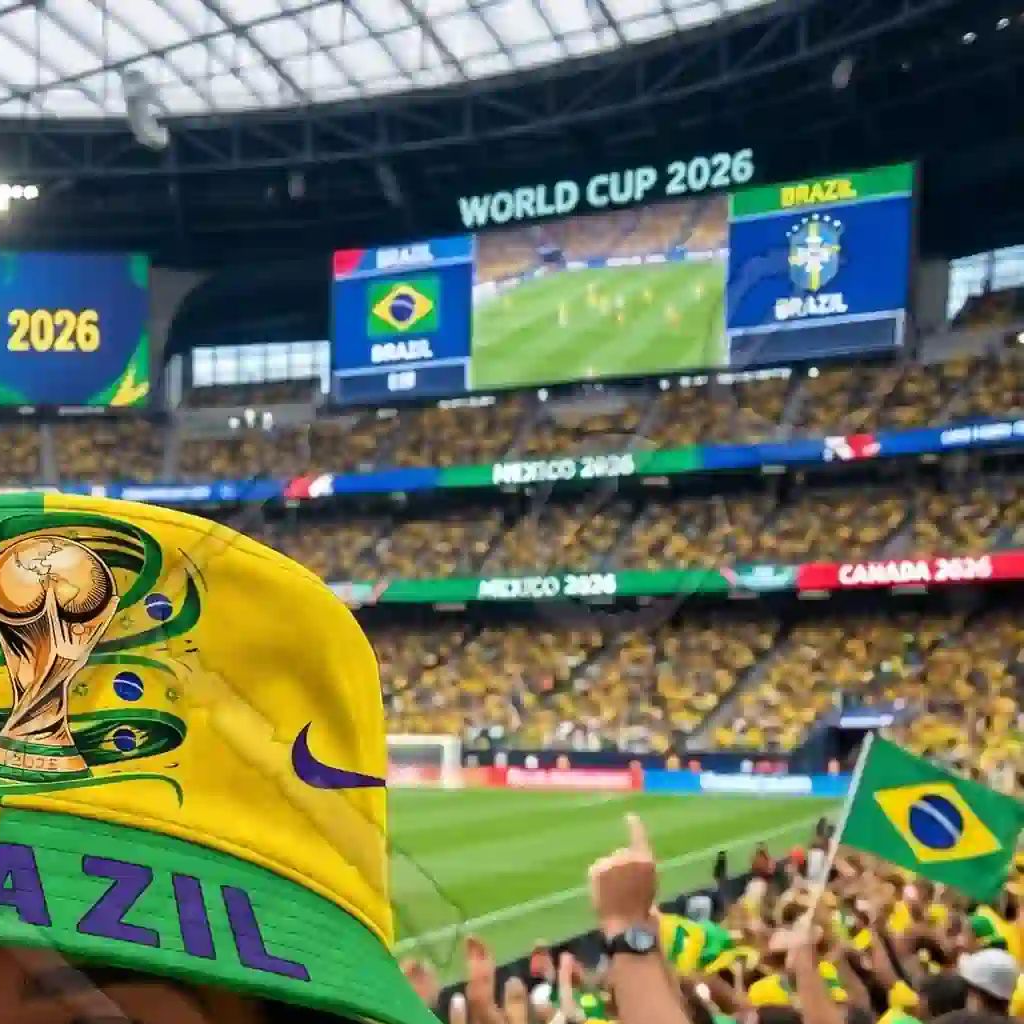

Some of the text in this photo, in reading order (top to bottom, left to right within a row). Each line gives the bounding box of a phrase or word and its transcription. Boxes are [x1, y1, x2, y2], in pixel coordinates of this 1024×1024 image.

[458, 148, 755, 229] WORLD CUP 2026
[6, 308, 101, 353] 2026
